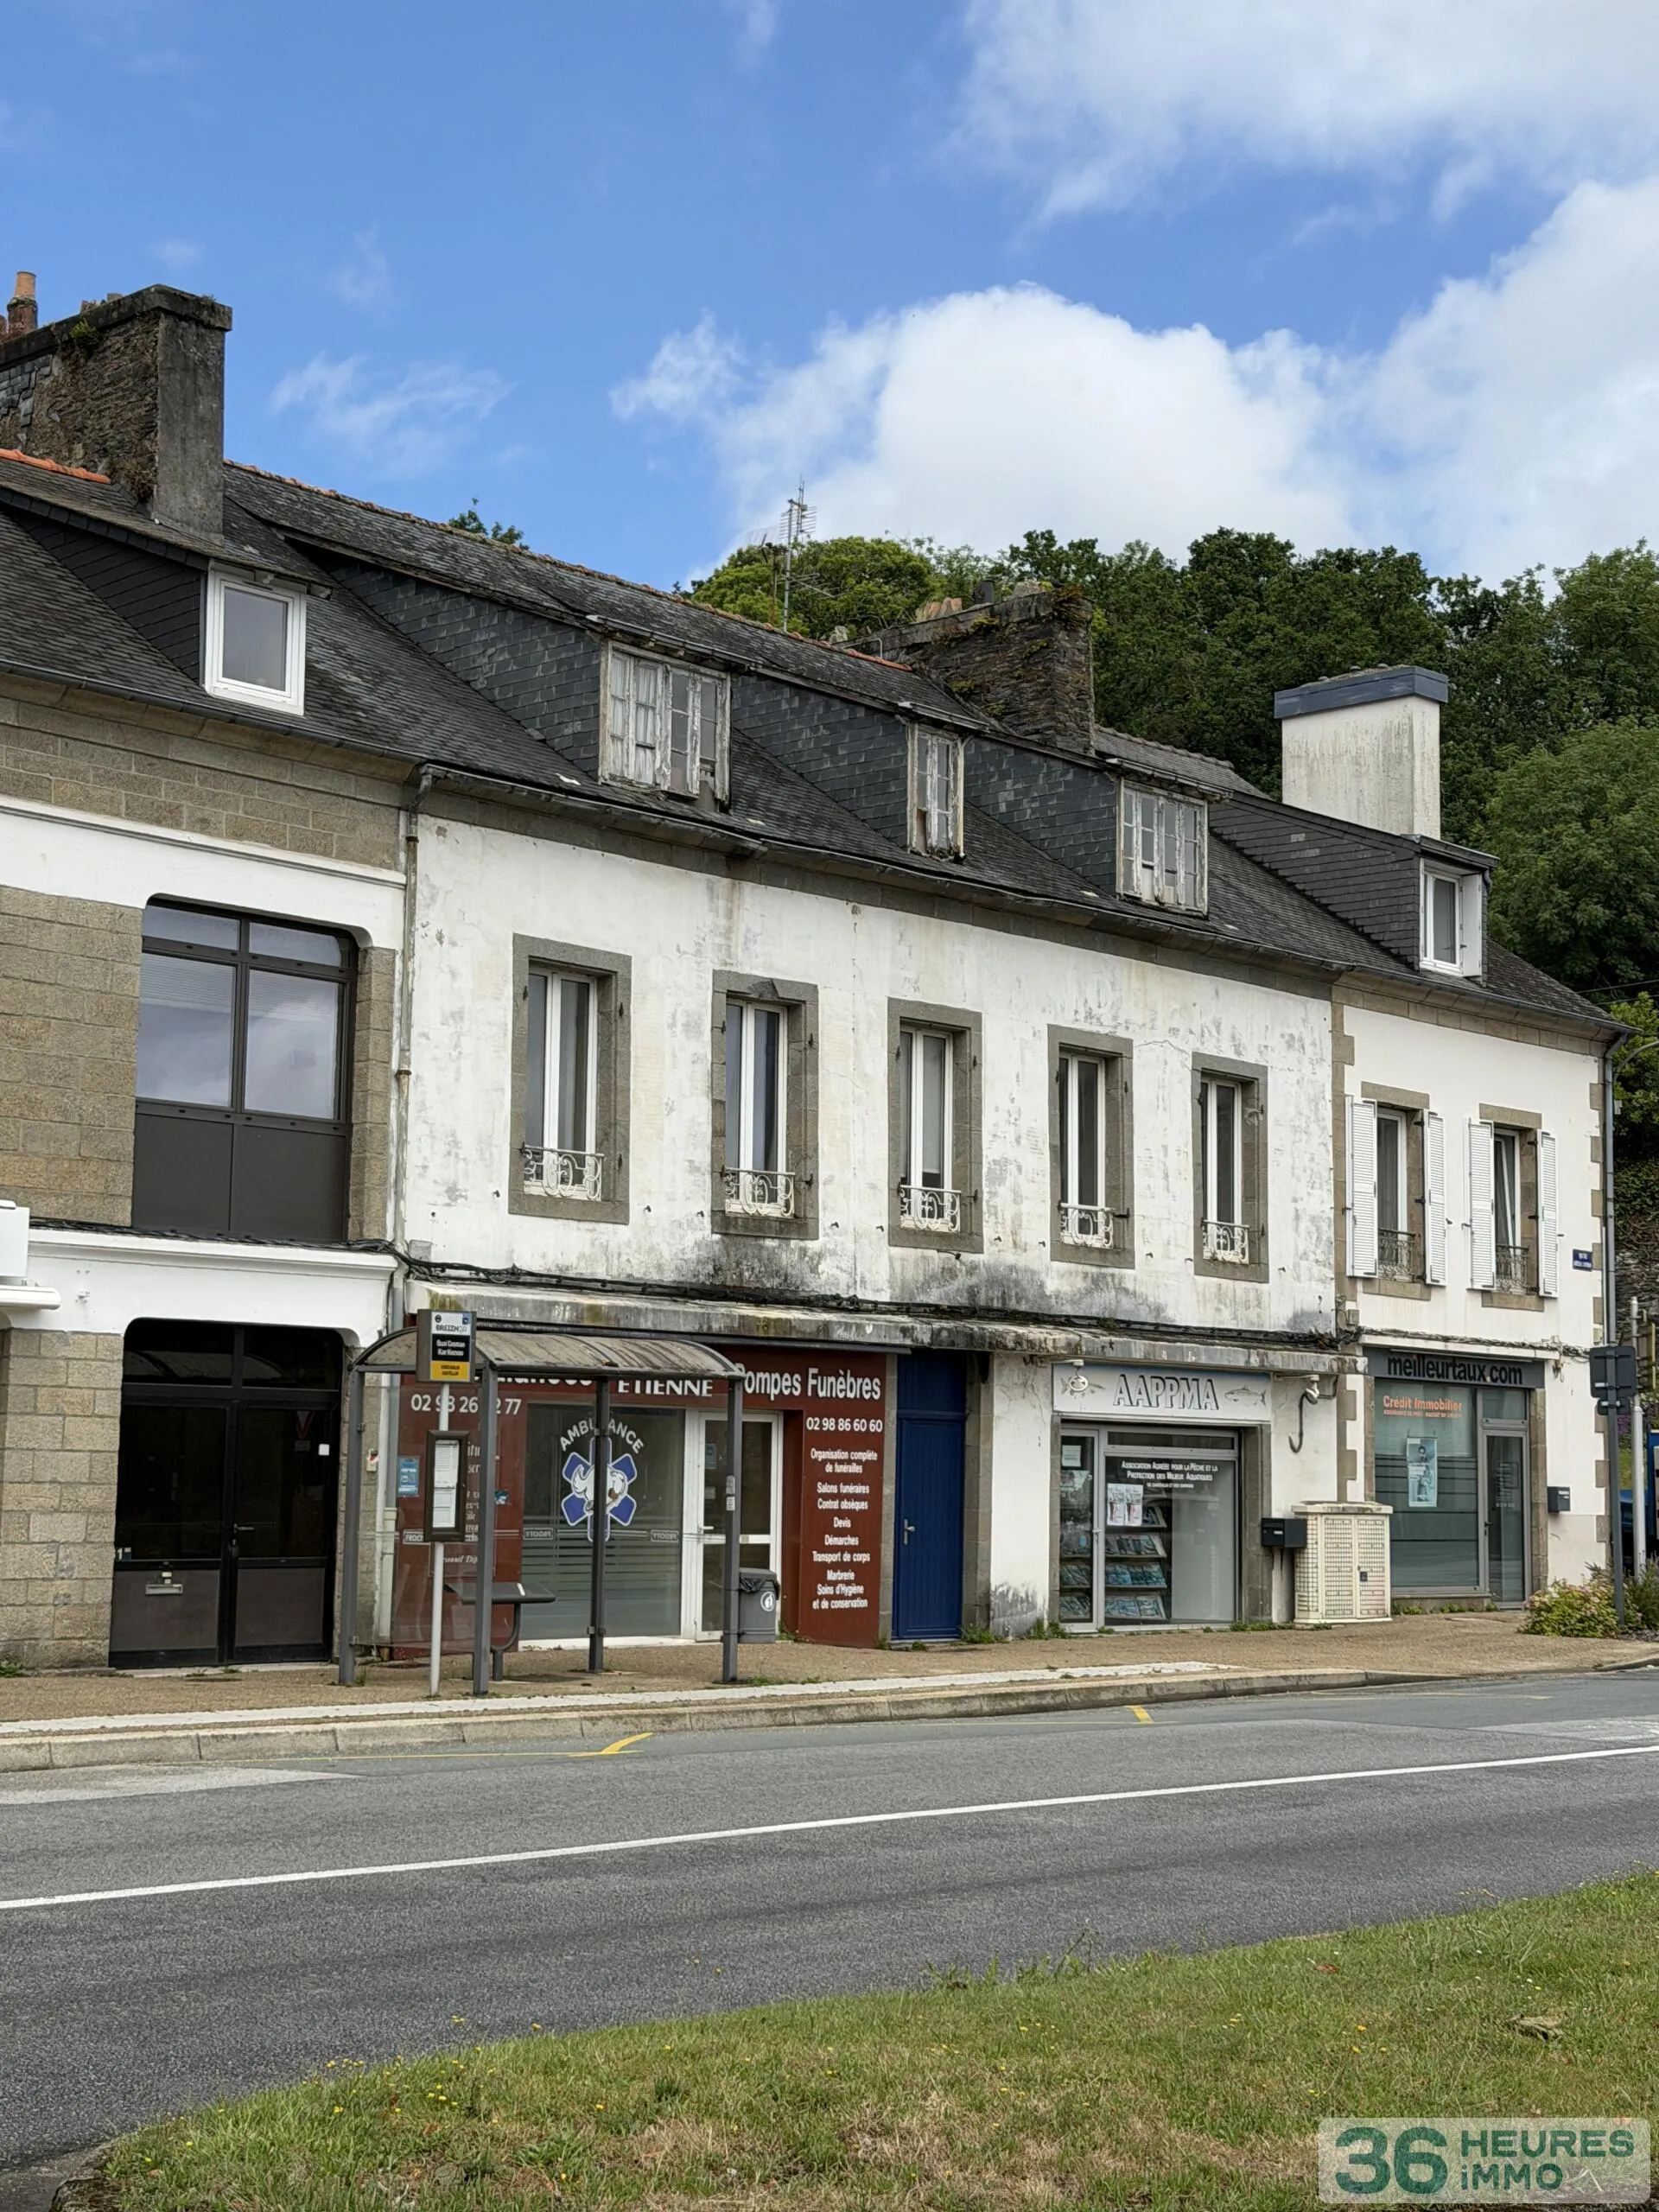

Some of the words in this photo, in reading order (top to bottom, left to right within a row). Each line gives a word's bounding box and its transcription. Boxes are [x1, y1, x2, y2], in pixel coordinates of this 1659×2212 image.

[1388, 1354, 1522, 1385] meilleurtaux.com
[808, 1367, 880, 1401] Funèbres
[1113, 1373, 1219, 1410] AAPPMA
[410, 1394, 431, 1411] 02
[459, 1395, 479, 1414] 26
[505, 1398, 522, 1415] 77
[1383, 1395, 1411, 1409] Crédit
[1414, 1398, 1462, 1412] Immobilier
[806, 1417, 820, 1431] 02
[823, 1417, 836, 1432] 98
[838, 1418, 851, 1432] 86
[854, 1419, 867, 1433] 60
[869, 1420, 883, 1433] 60
[560, 1417, 645, 1454] AMBANCE
[810, 1447, 849, 1462] Organisation
[850, 1450, 878, 1462] complète
[825, 1462, 833, 1473] de
[835, 1462, 862, 1474] funérailles
[817, 1482, 838, 1494] Salons
[840, 1482, 869, 1494] funéraires
[817, 1497, 839, 1510] Contrat
[841, 1498, 868, 1511] obsèques
[833, 1516, 851, 1528] Devis
[824, 1534, 859, 1546] Démarches
[812, 1551, 841, 1564] Transport
[842, 1551, 851, 1562] de
[853, 1553, 870, 1564] corps
[827, 1569, 855, 1580] Marbrerie
[817, 1583, 834, 1595] Soins
[812, 1599, 819, 1609] et
[821, 1598, 829, 1609] de
[830, 1598, 868, 1609] conservation
